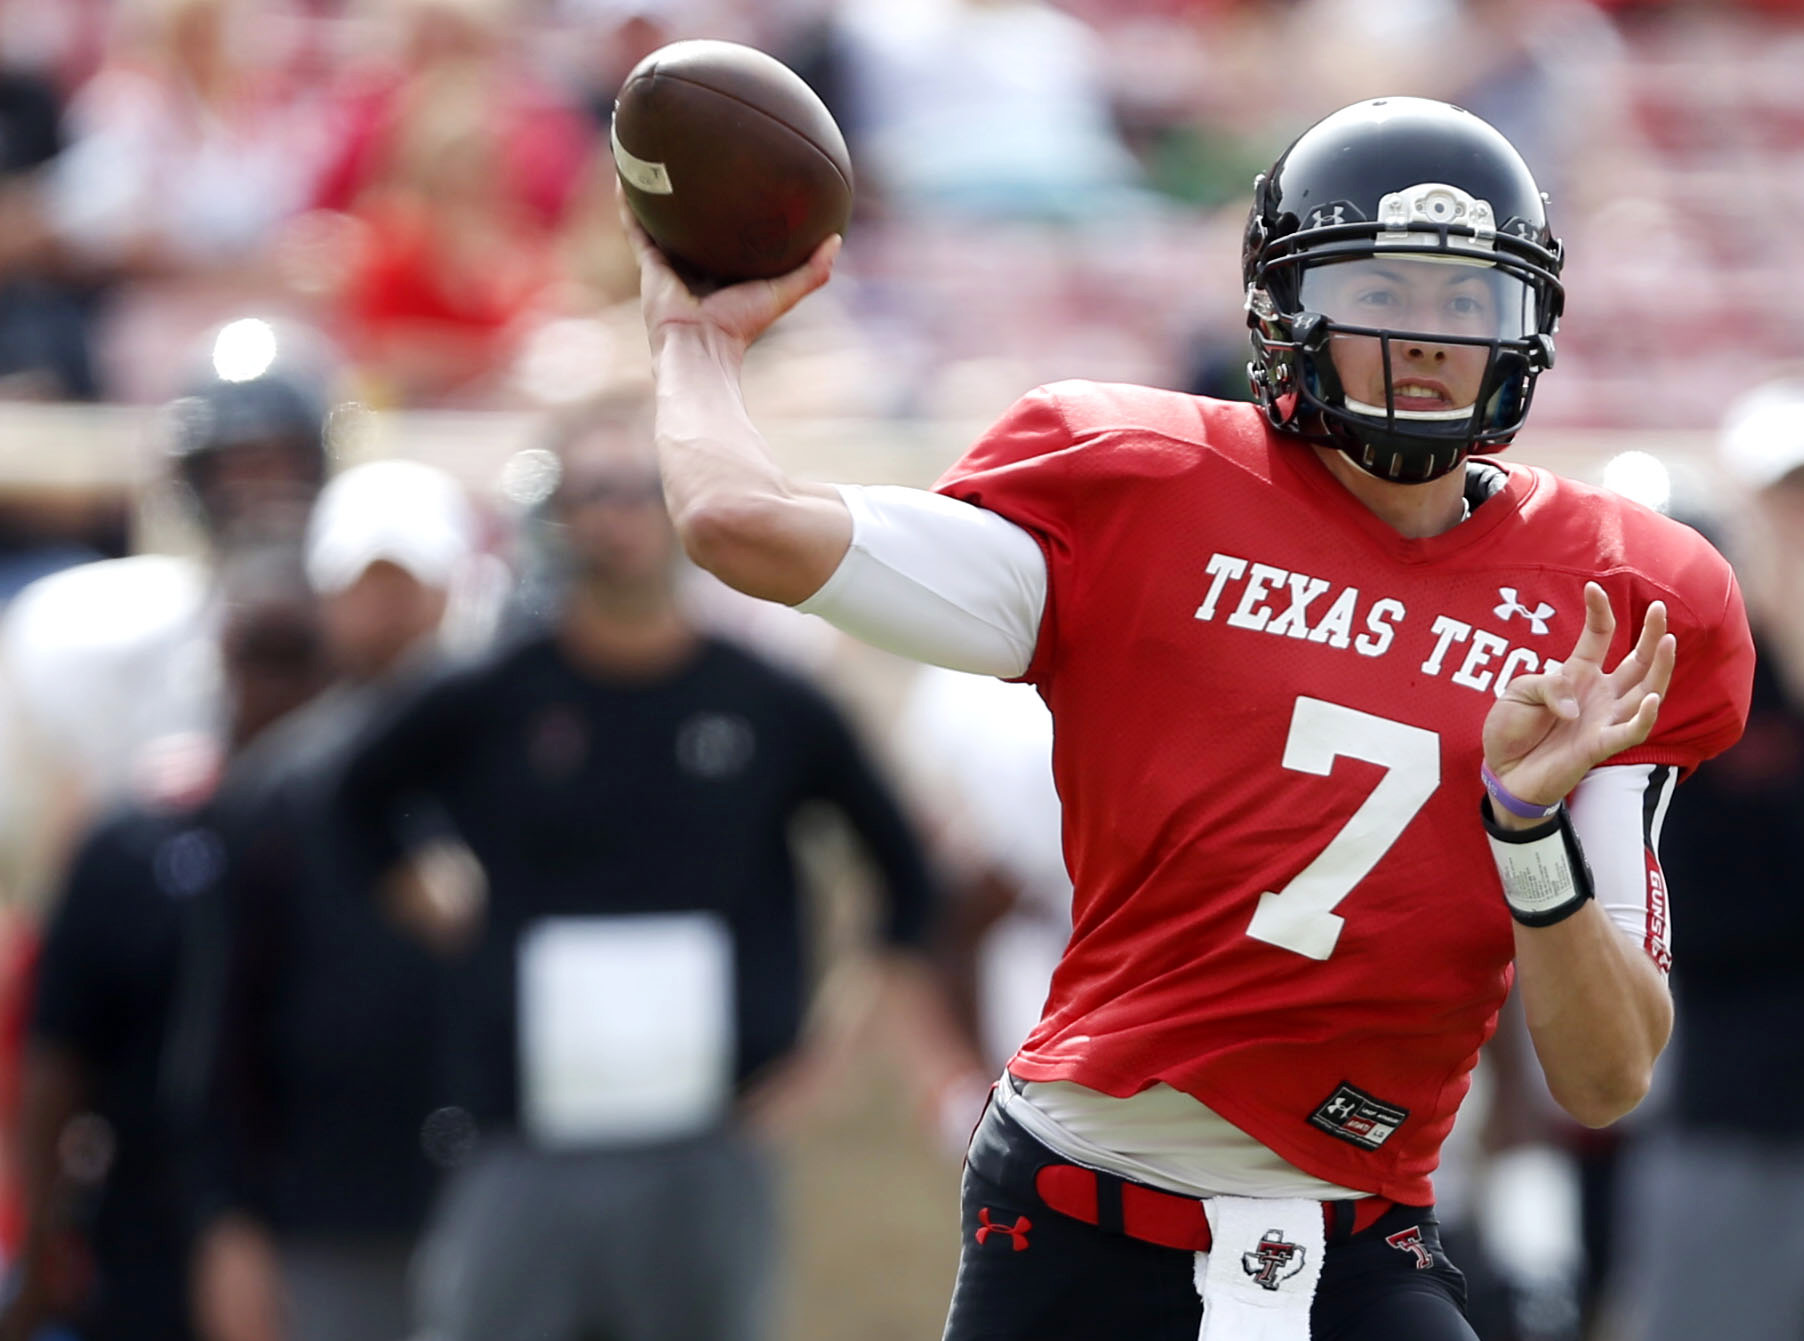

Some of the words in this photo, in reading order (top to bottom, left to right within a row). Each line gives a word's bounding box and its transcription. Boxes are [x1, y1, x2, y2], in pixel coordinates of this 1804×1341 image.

[1194, 553, 1407, 657] TEXAS
[1421, 614, 1566, 698] TEC
[1245, 695, 1441, 961] 7
[1649, 870, 1665, 937] GUNS
